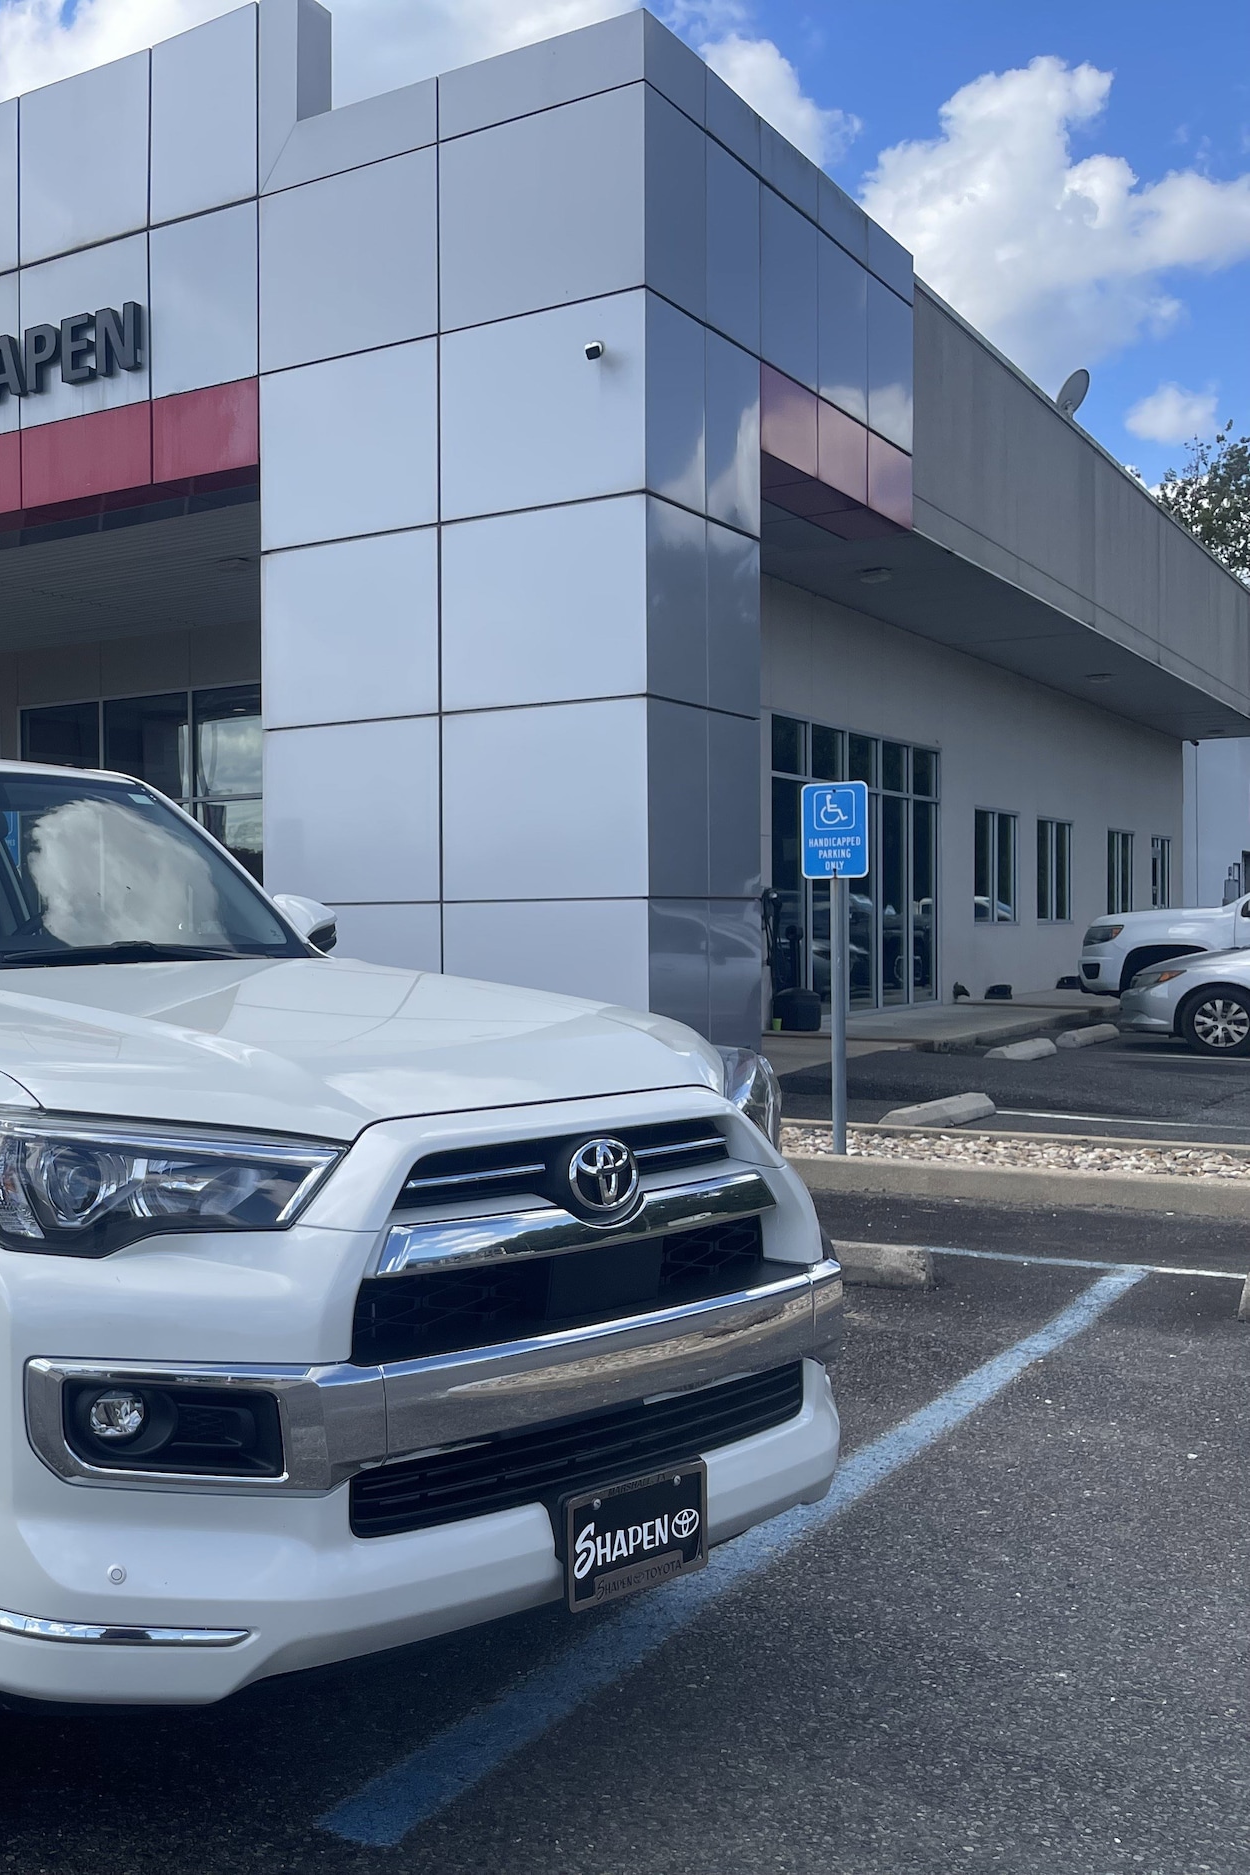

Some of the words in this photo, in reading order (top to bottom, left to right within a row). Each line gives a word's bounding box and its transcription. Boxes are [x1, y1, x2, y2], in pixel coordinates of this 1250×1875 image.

[808, 836, 861, 848] HANDICAPPED
[818, 848, 851, 859] PARKING
[825, 861, 844, 871] ONLY
[574, 1514, 669, 1579] SHAPEN
[596, 1574, 633, 1600] SHAPEN
[645, 1559, 682, 1581] TOYOTA
